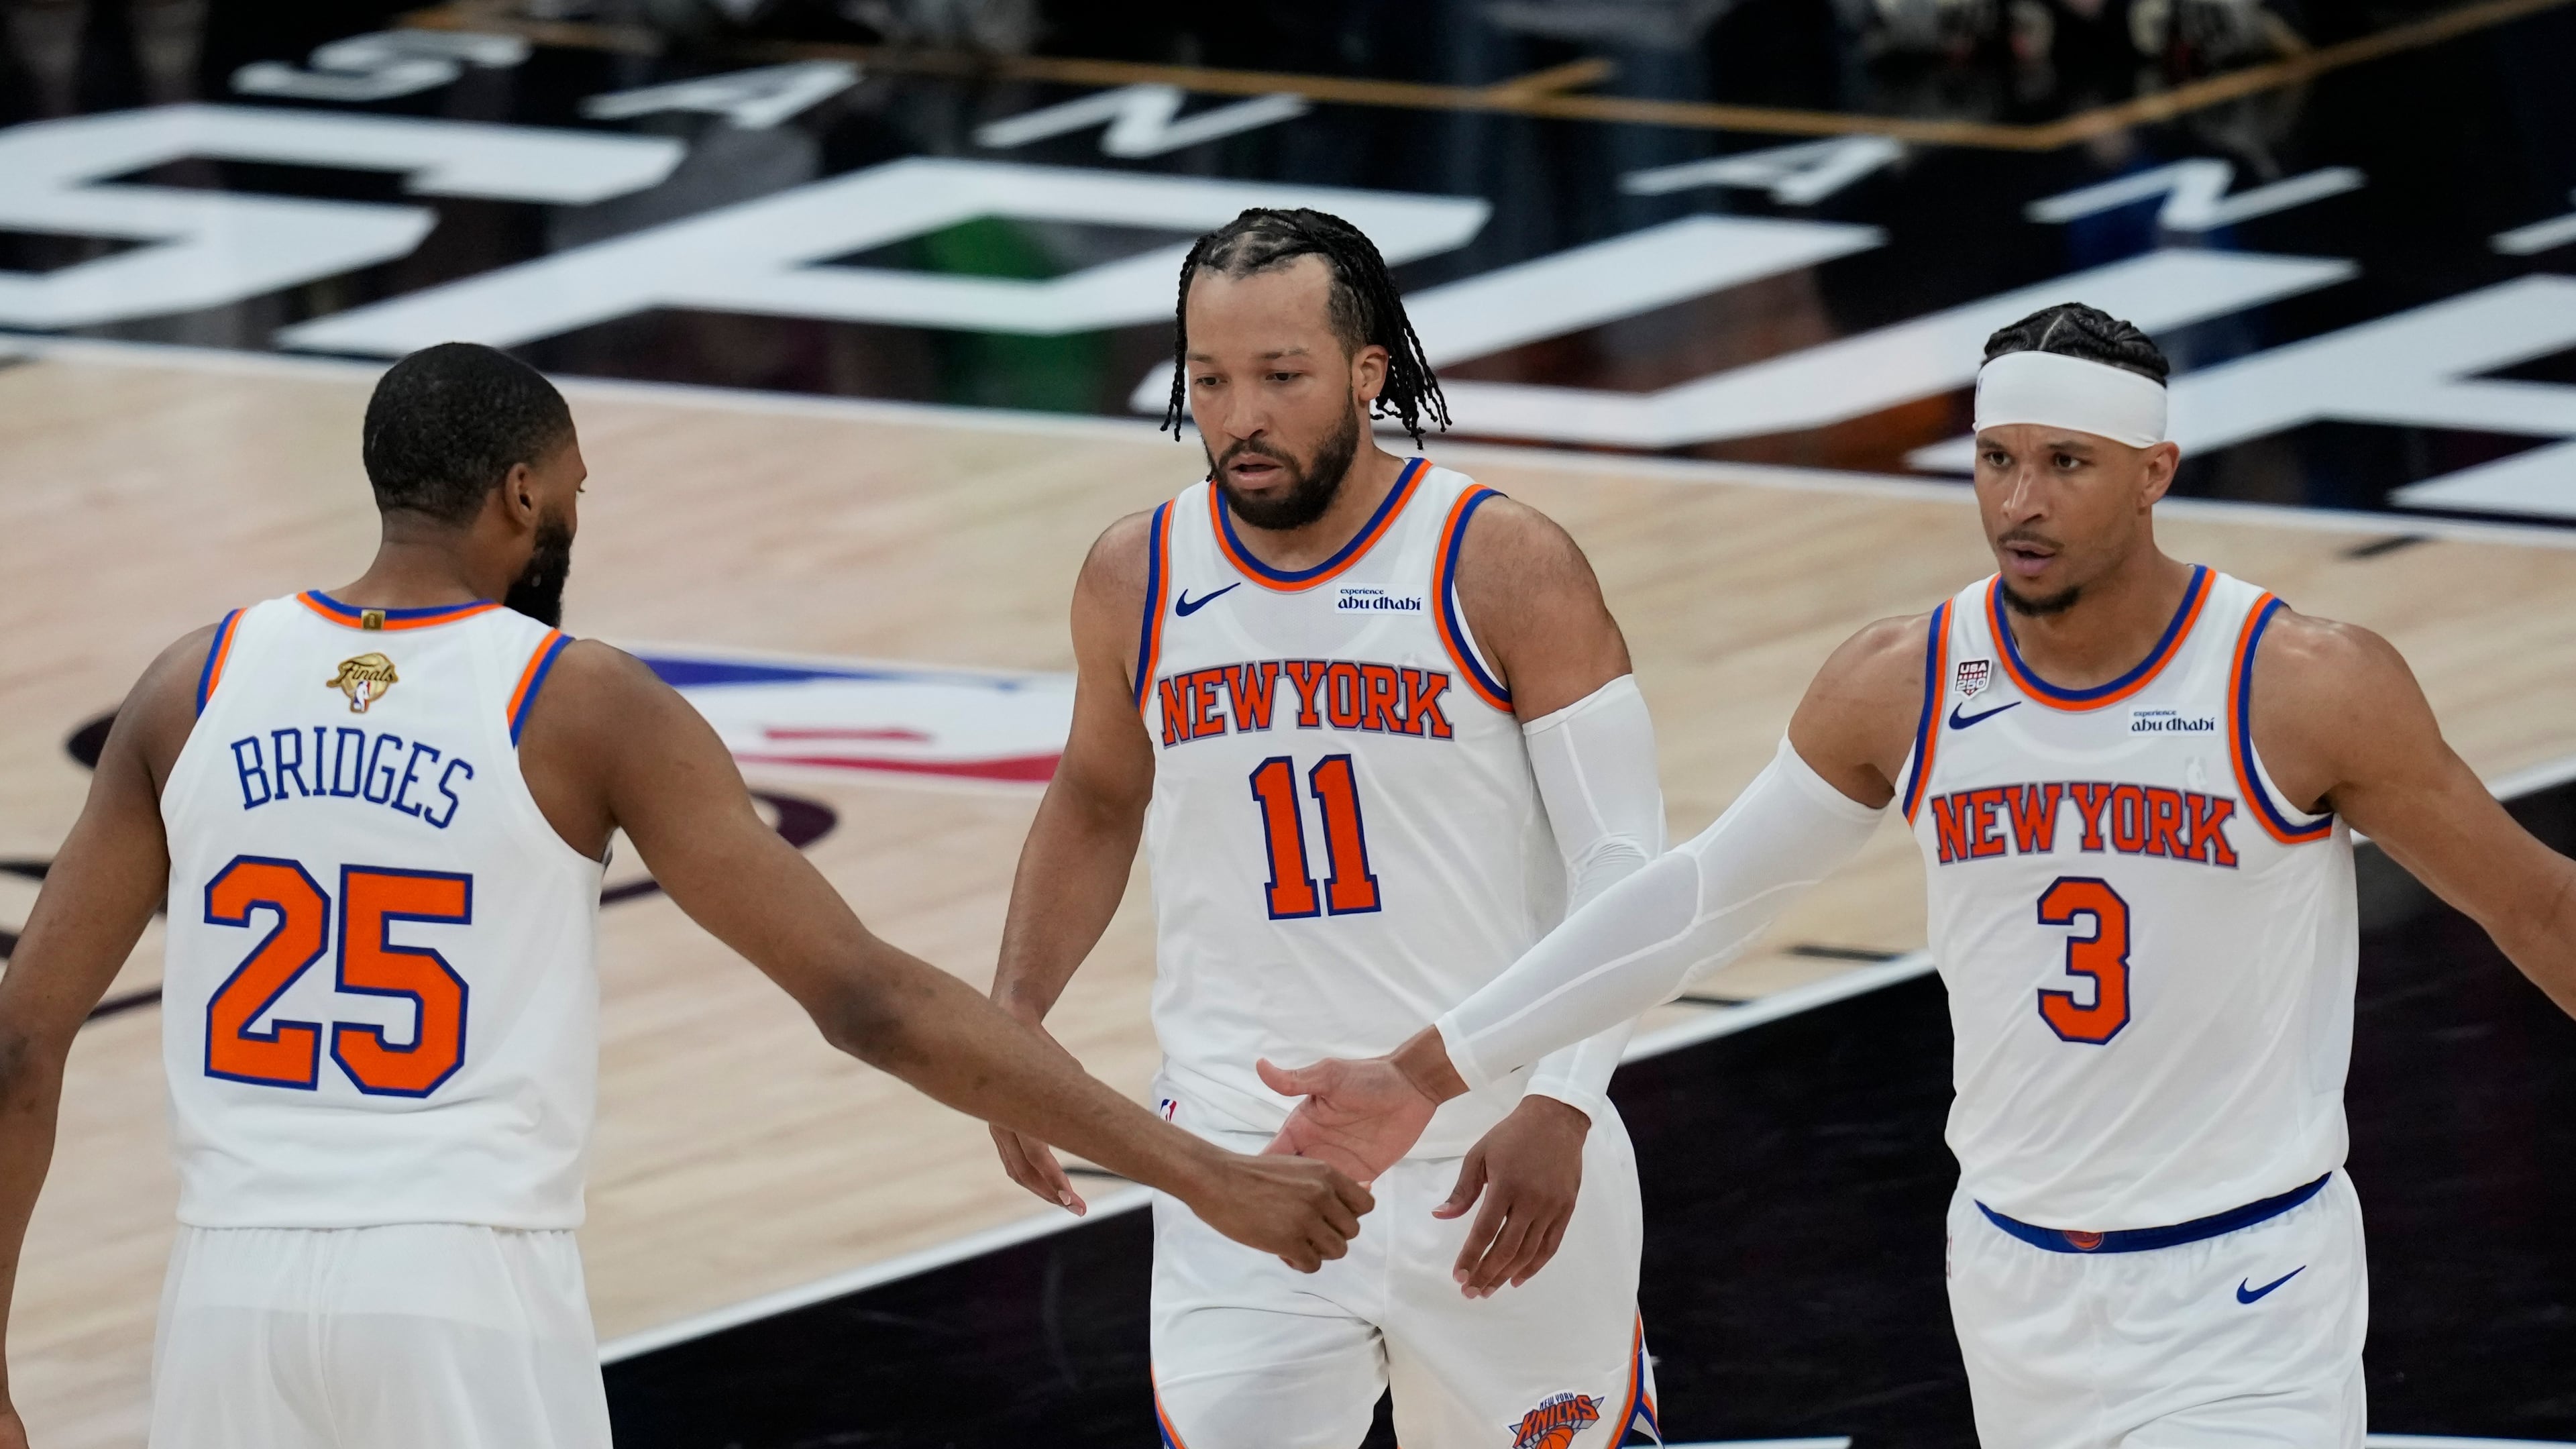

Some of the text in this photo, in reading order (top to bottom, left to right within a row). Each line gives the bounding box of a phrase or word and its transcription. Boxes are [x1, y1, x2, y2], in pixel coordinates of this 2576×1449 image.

[1338, 596, 1370, 609] abu
[1340, 588, 1385, 596] experience
[335, 661, 394, 684] Finals
[1956, 678, 1986, 691] 250
[1960, 662, 1988, 674] USA
[1158, 659, 1455, 749] NEW YORK
[2131, 718, 2162, 732] abu
[231, 727, 474, 829] BRIDGES
[1249, 753, 1382, 920] 11
[1930, 782, 2240, 870] NEW YORK
[204, 855, 474, 1098] 25
[2037, 876, 2131, 1045] 3
[1540, 1392, 1574, 1410] NEW YORK
[1512, 1395, 1600, 1449] KNICKS
